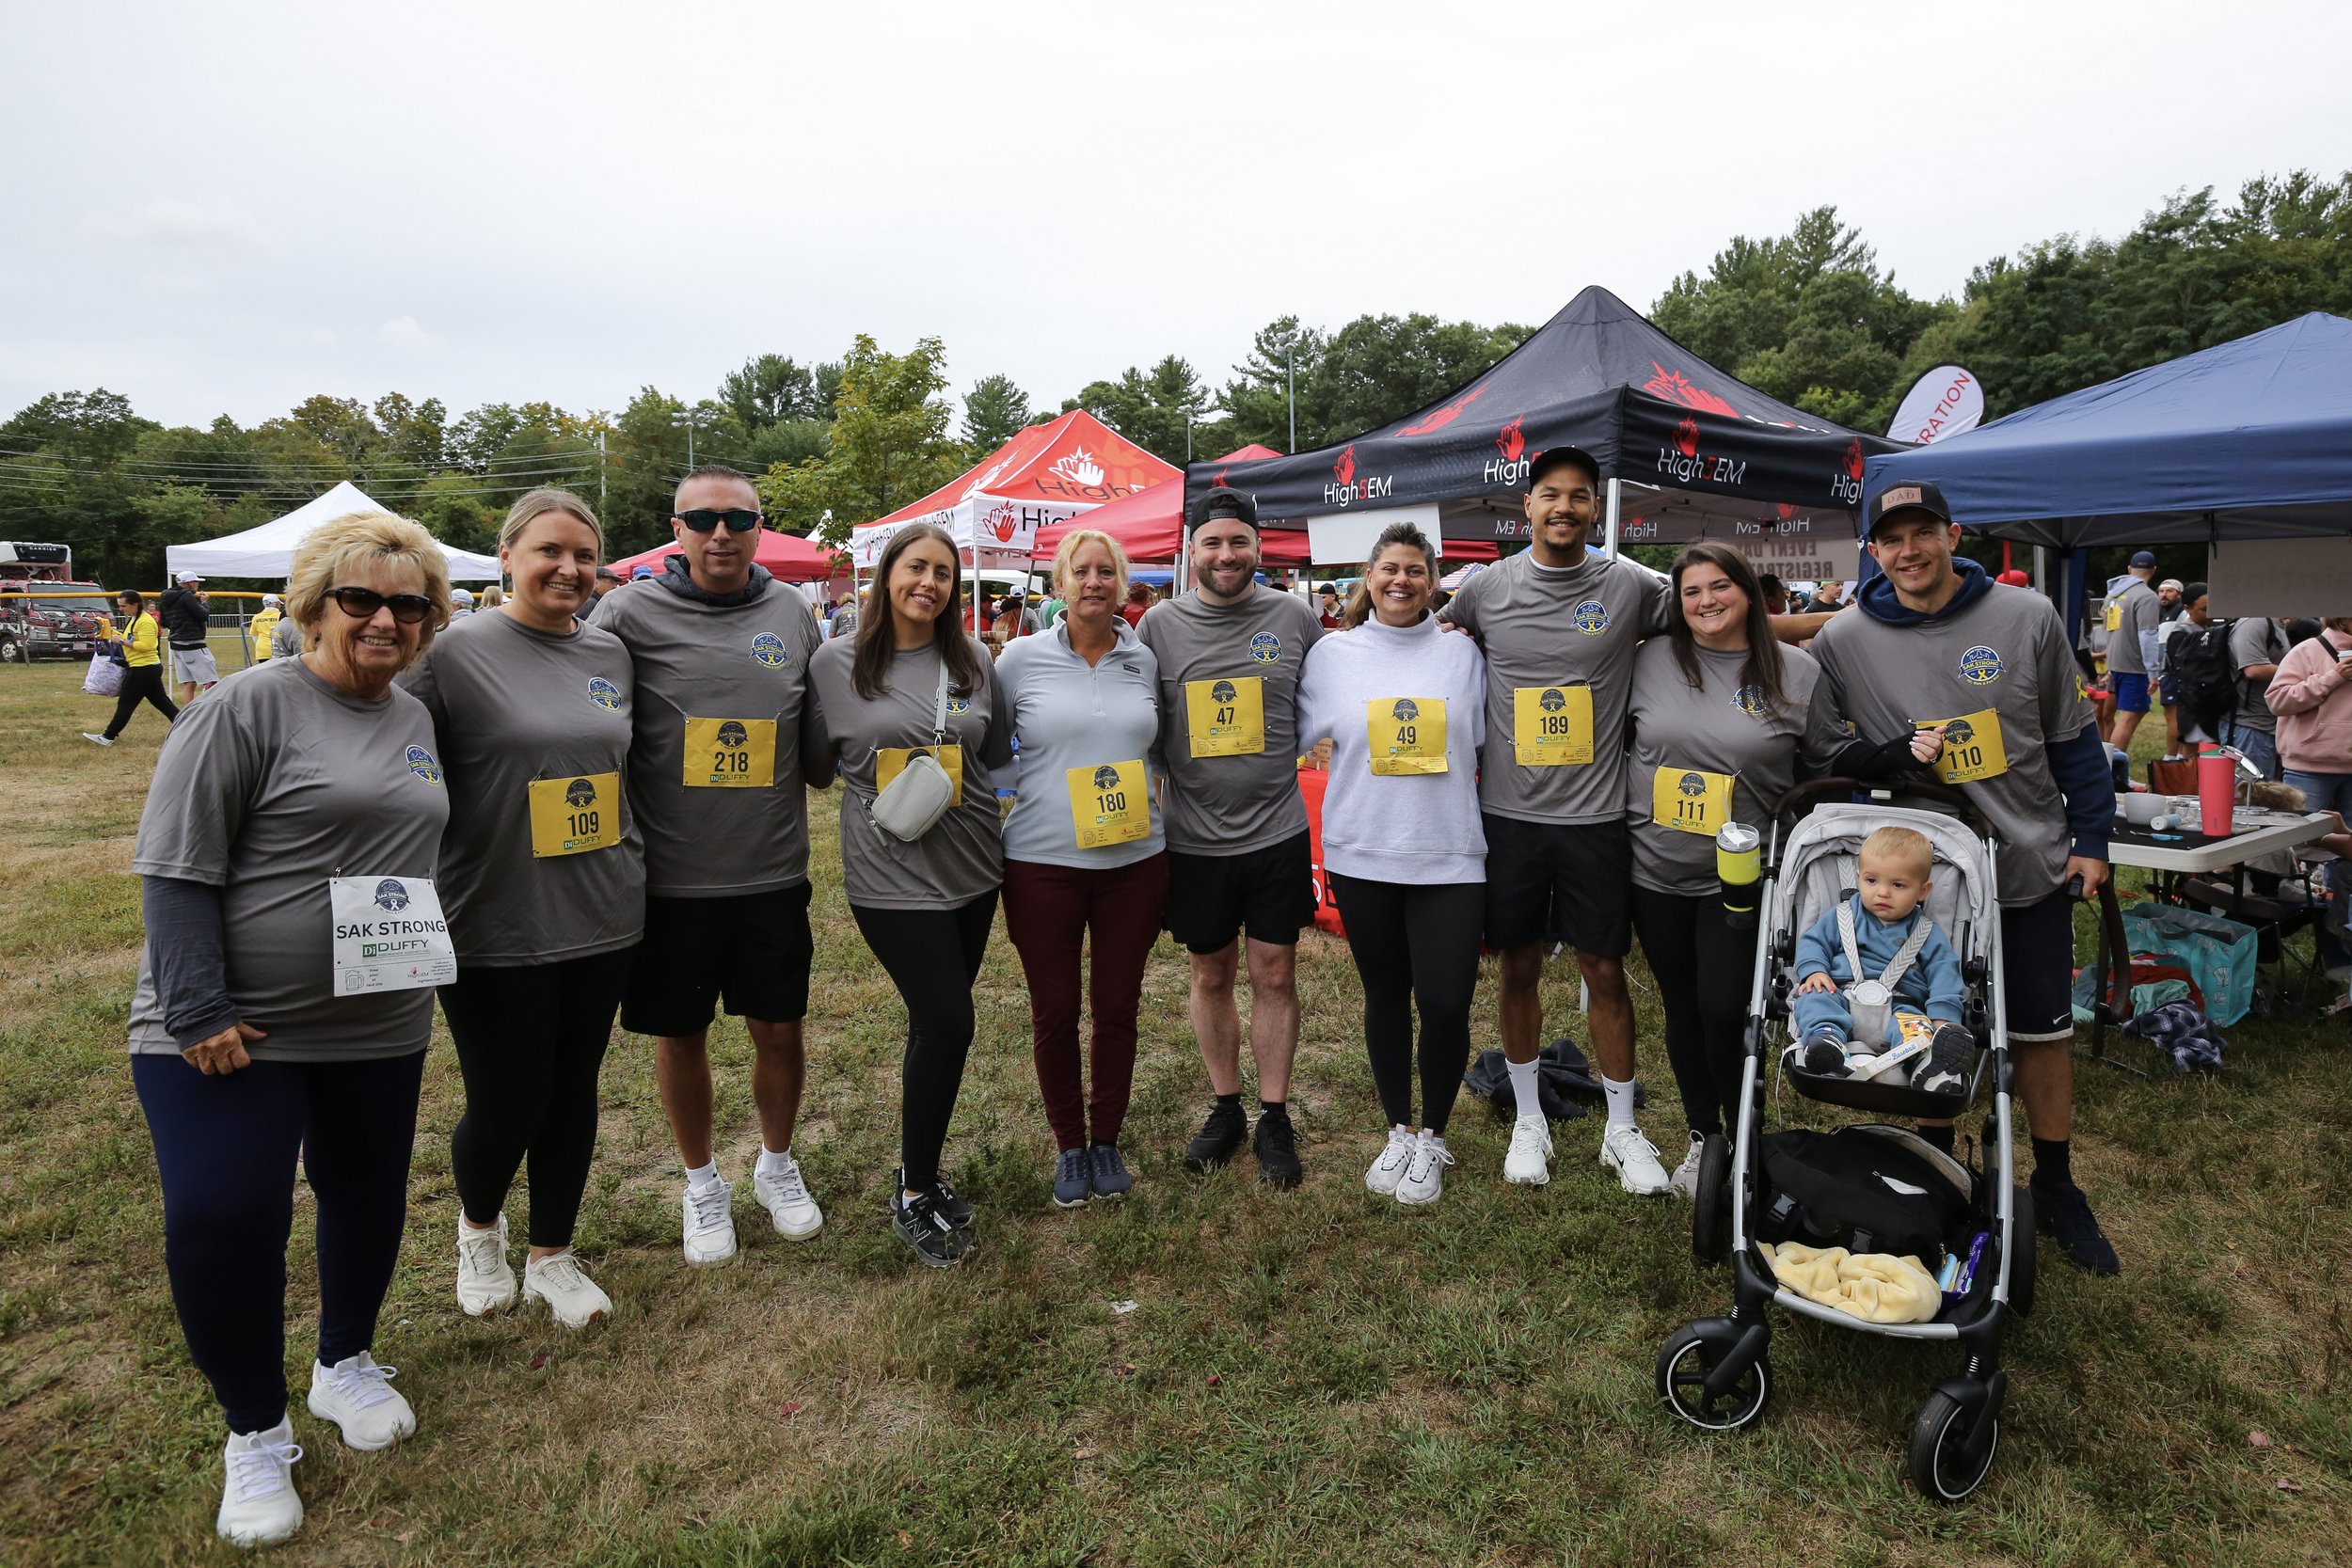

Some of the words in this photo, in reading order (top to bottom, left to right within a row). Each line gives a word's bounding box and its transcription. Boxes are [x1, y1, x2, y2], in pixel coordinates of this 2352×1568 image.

[1914, 372, 1971, 444] RATION
[1484, 451, 1544, 486] High
[1658, 448, 1746, 484] High5EM
[1325, 475, 1393, 507] High5EM
[1887, 491, 1915, 504] DAD
[1022, 506, 1076, 531] Hi
[1216, 706, 1234, 725] 47
[1540, 715, 1568, 735] 189
[1397, 725, 1416, 744] 49
[714, 751, 749, 772] 218
[1947, 745, 1982, 769] 110
[1955, 766, 1986, 777] DUFFY
[1096, 791, 1126, 813] 180
[1677, 799, 1705, 821] 111
[567, 811, 598, 837] 109
[1104, 812, 1129, 820] DUFFY
[1679, 818, 1707, 829] DUFFY
[573, 834, 602, 846] DUFFY
[336, 923, 374, 939] SAK
[378, 920, 446, 936] STRONG
[363, 944, 377, 958] Di
[378, 939, 429, 952] DUFFY
[1891, 1042, 1917, 1061] Baseball
